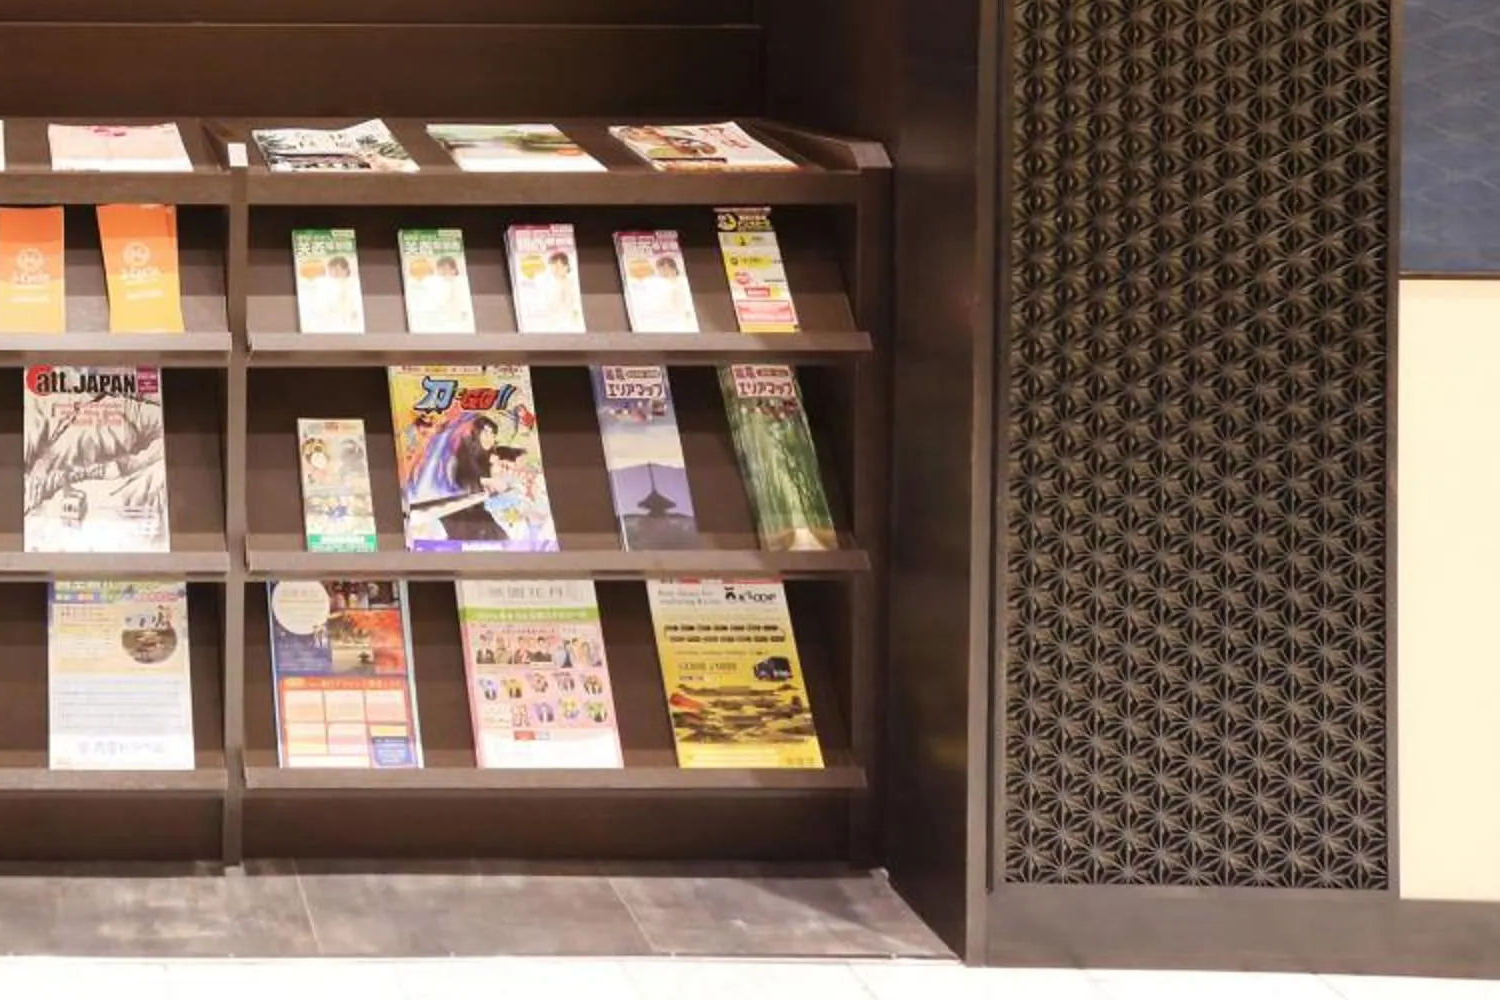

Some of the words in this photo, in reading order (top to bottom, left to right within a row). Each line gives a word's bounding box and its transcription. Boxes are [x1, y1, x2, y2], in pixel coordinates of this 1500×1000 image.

[608, 383, 663, 397] エリアマップ
[738, 381, 793, 395] エリアマップ
